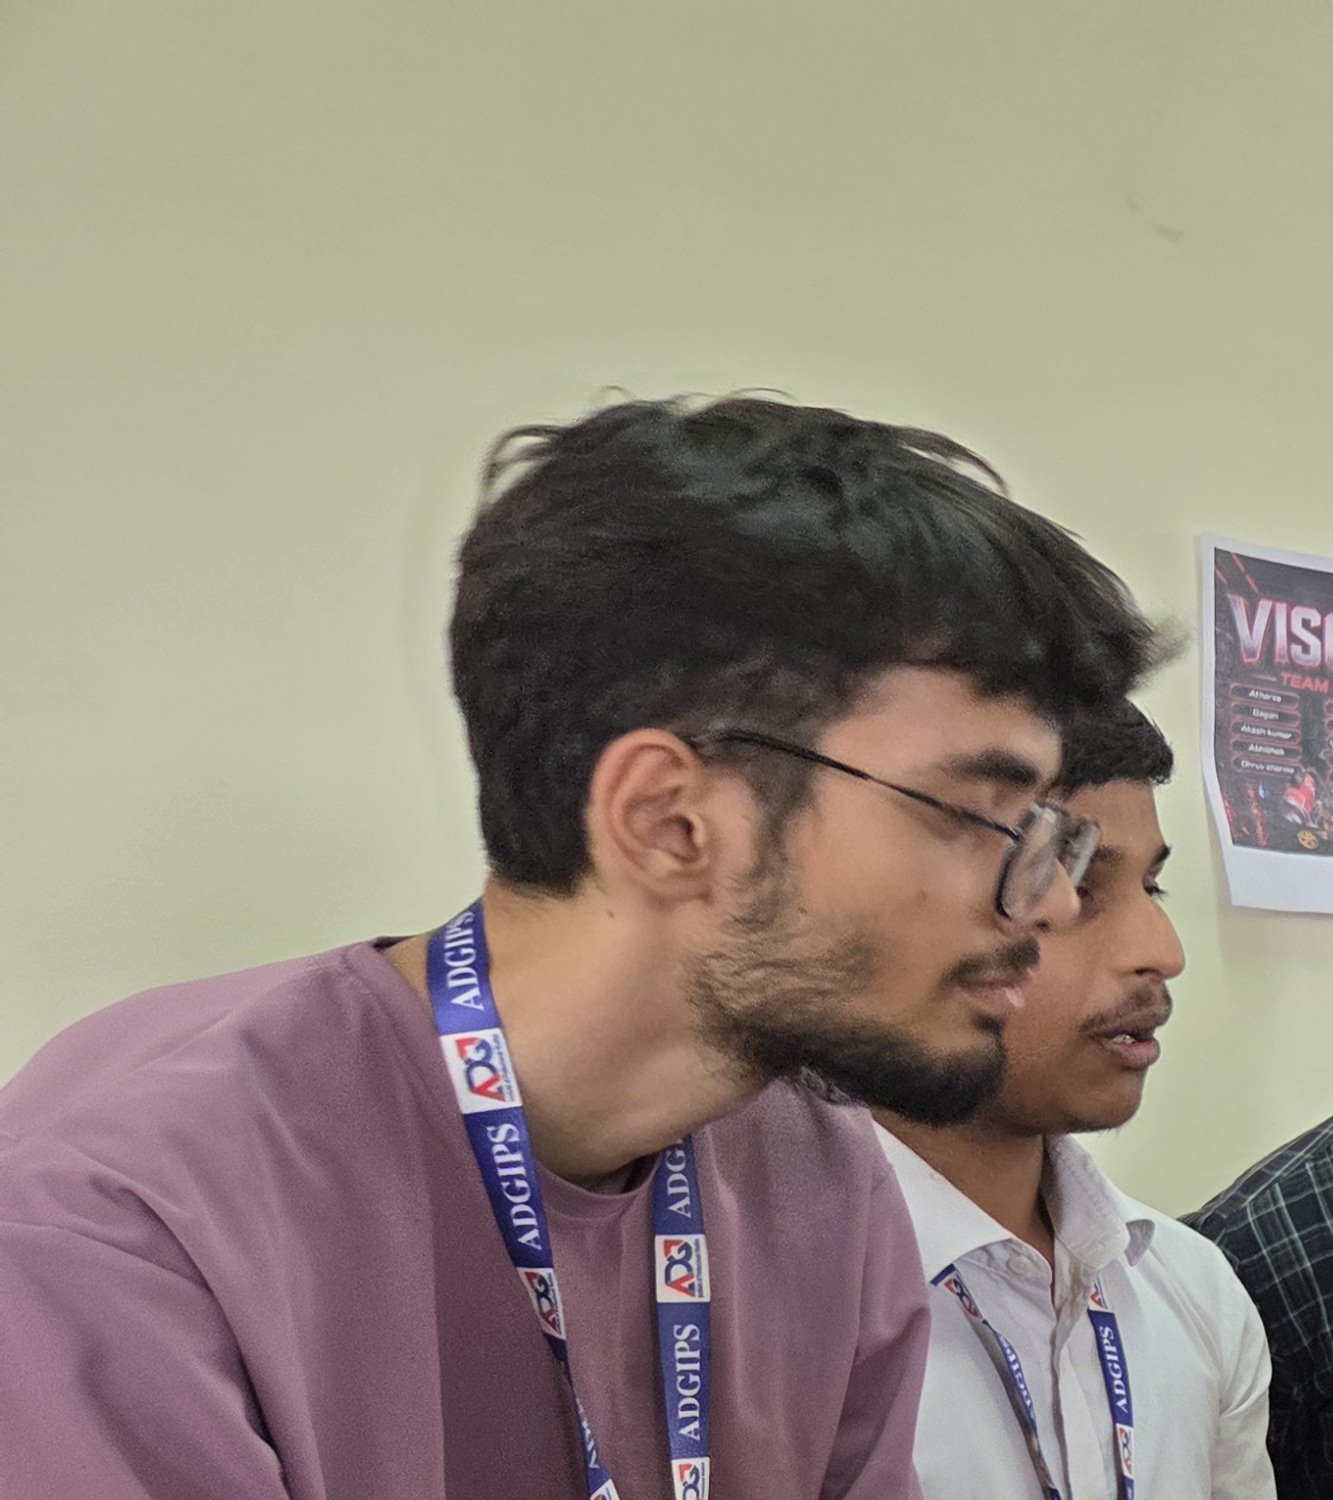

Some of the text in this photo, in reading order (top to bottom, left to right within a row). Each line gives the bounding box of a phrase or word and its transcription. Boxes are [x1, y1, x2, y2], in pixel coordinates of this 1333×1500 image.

[1281, 672, 1330, 693] TEAM
[444, 911, 484, 1011] ADGIPS
[486, 1122, 542, 1250] ADGIPS
[666, 1149, 691, 1218] ADG
[673, 1323, 701, 1441] ADGIPS
[1100, 1325, 1129, 1414] ADGIPS
